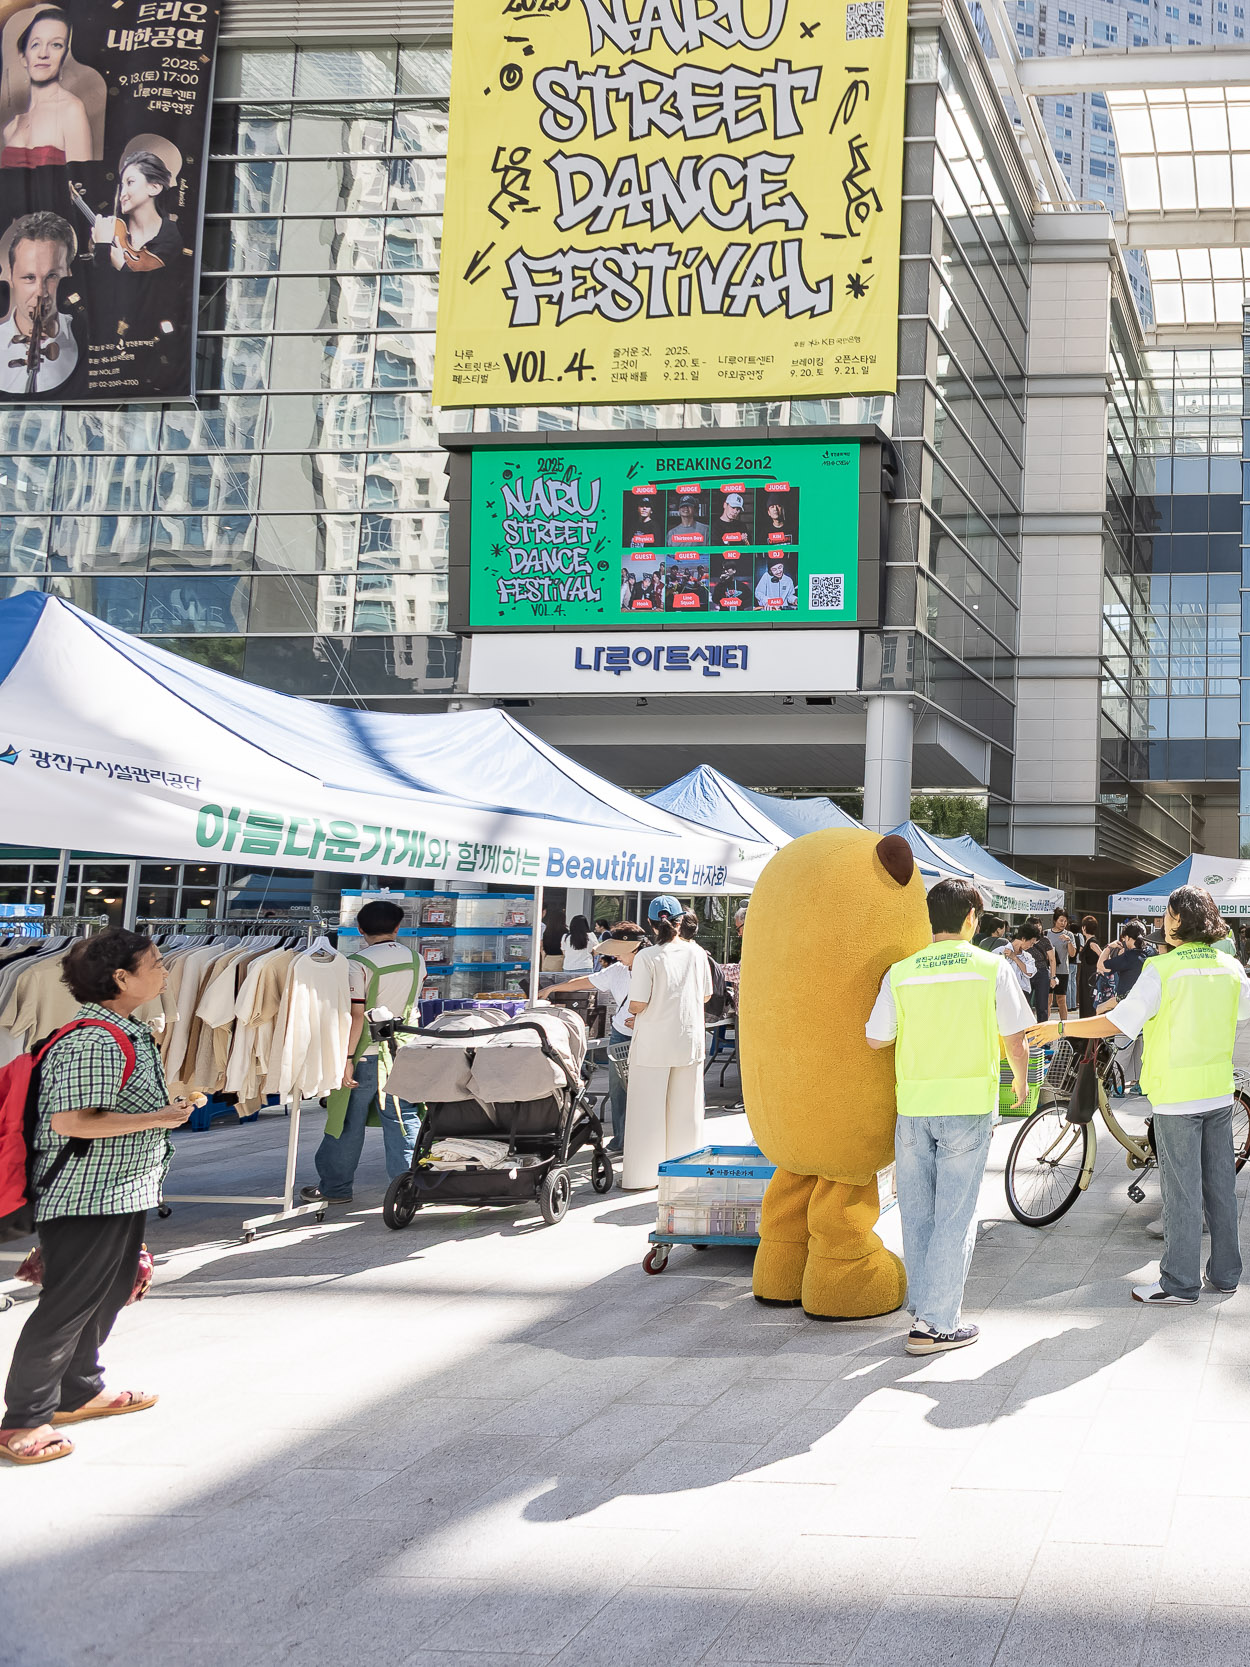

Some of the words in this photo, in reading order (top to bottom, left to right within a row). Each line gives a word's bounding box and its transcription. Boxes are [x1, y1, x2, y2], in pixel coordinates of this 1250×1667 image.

[137, 1, 208, 24] 트리오
[106, 27, 204, 52] 내한공연
[161, 57, 200, 71] 2025.
[163, 71, 199, 85] 17:00
[133, 87, 197, 102] 나루아트센터
[532, 59, 822, 143] STREET
[149, 100, 195, 116] 대공연장
[543, 149, 809, 234] DANCE
[454, 349, 474, 359] 나루
[612, 348, 639, 358] 즐거운
[664, 346, 690, 356] 2025.
[453, 361, 482, 372] 스트릿
[484, 361, 501, 371] 댄스
[611, 360, 638, 370] 그것이
[664, 360, 673, 369] 9.
[674, 359, 689, 369] 20.
[690, 358, 700, 368] 토
[717, 354, 775, 366] 나루아트센터
[791, 357, 824, 367] 브레이킹
[834, 354, 877, 365] 오픈스타일
[610, 372, 628, 383] 진짜
[630, 371, 648, 382] 배틀
[663, 372, 672, 381] 9.
[673, 372, 688, 381] 21.
[690, 370, 700, 381] 일
[717, 369, 764, 381] 야외공연장
[861, 365, 870, 375] 일
[452, 373, 489, 384] 페스티벌
[537, 457, 565, 473] 2025
[656, 457, 732, 472] BREAKING
[735, 455, 772, 470] 2on2
[500, 476, 601, 519] NARU
[502, 517, 598, 546] STREET
[507, 545, 594, 576] DANCE
[678, 552, 697, 560] GUEST
[574, 644, 748, 677] 나루아트센터
[29, 749, 202, 792] 광진구시설관리공단
[196, 803, 451, 869] 아름다운가게와
[456, 841, 541, 877] 함께하는
[546, 846, 655, 883] Beautiful
[658, 856, 690, 886] 광진
[692, 864, 727, 886] 바자회
